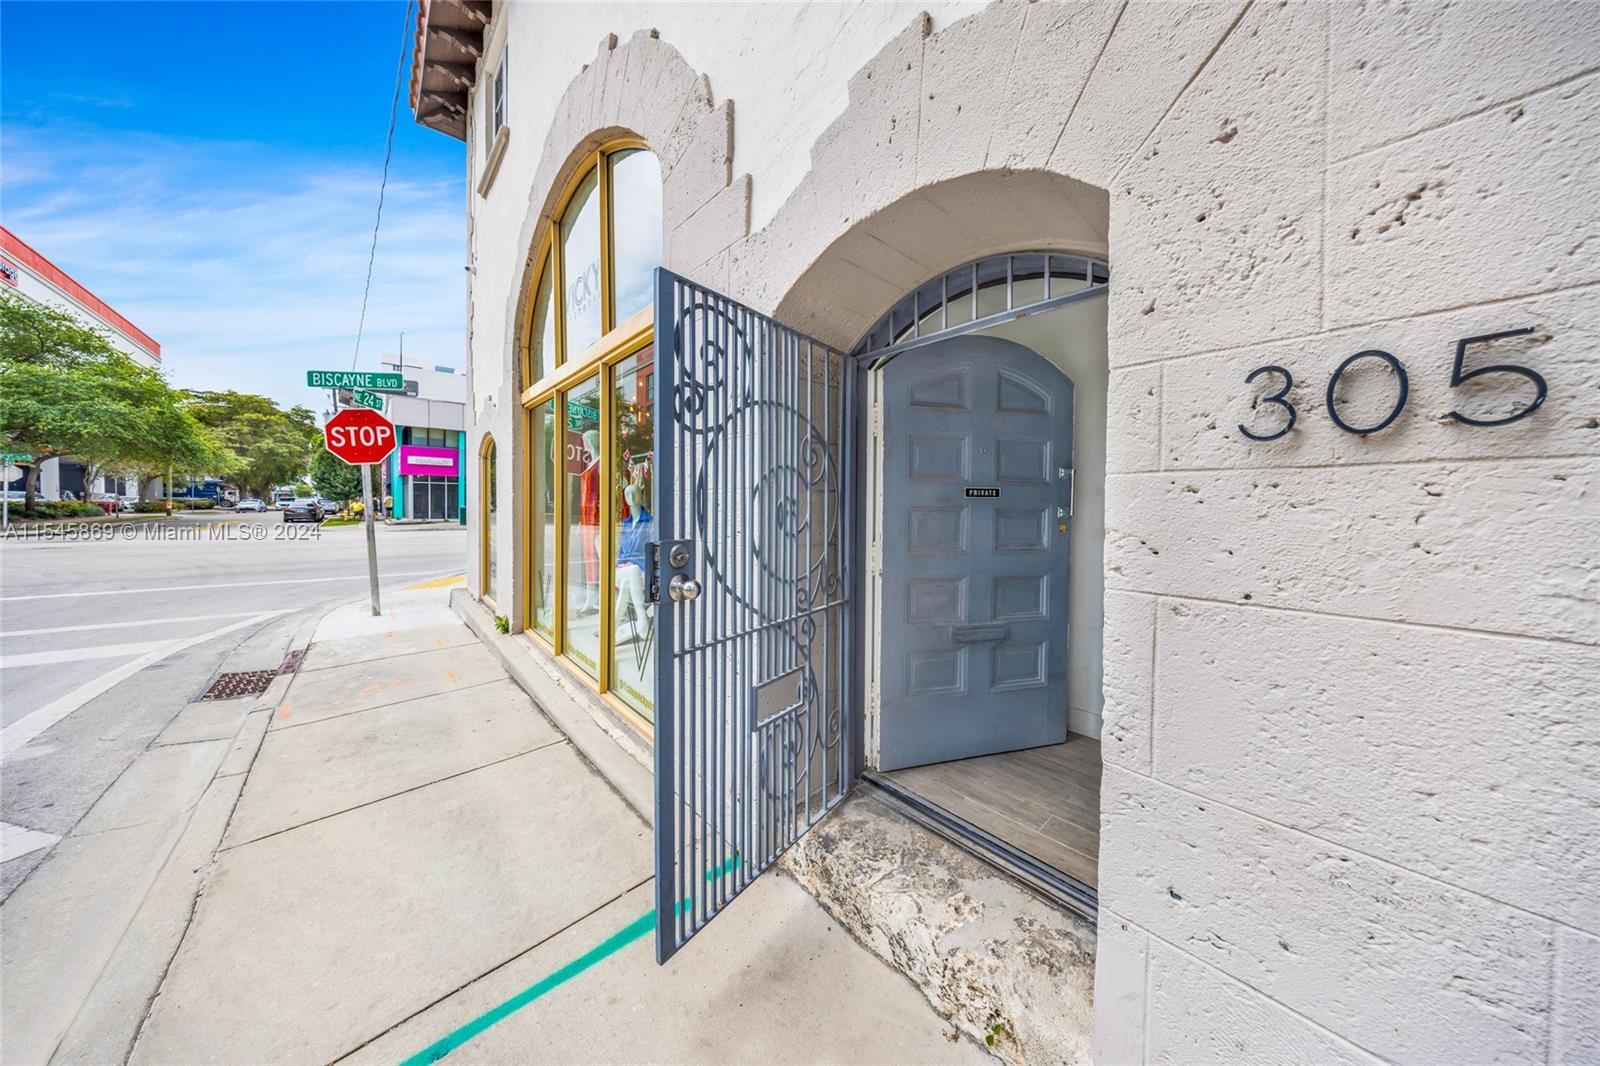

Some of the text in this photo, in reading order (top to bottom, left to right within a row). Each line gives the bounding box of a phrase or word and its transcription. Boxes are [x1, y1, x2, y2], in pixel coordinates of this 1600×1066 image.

[312, 373, 398, 388] BISCAYNE BLVD
[1237, 326, 1548, 442] 305
[364, 392, 374, 406] 24
[330, 425, 391, 447] STOP
